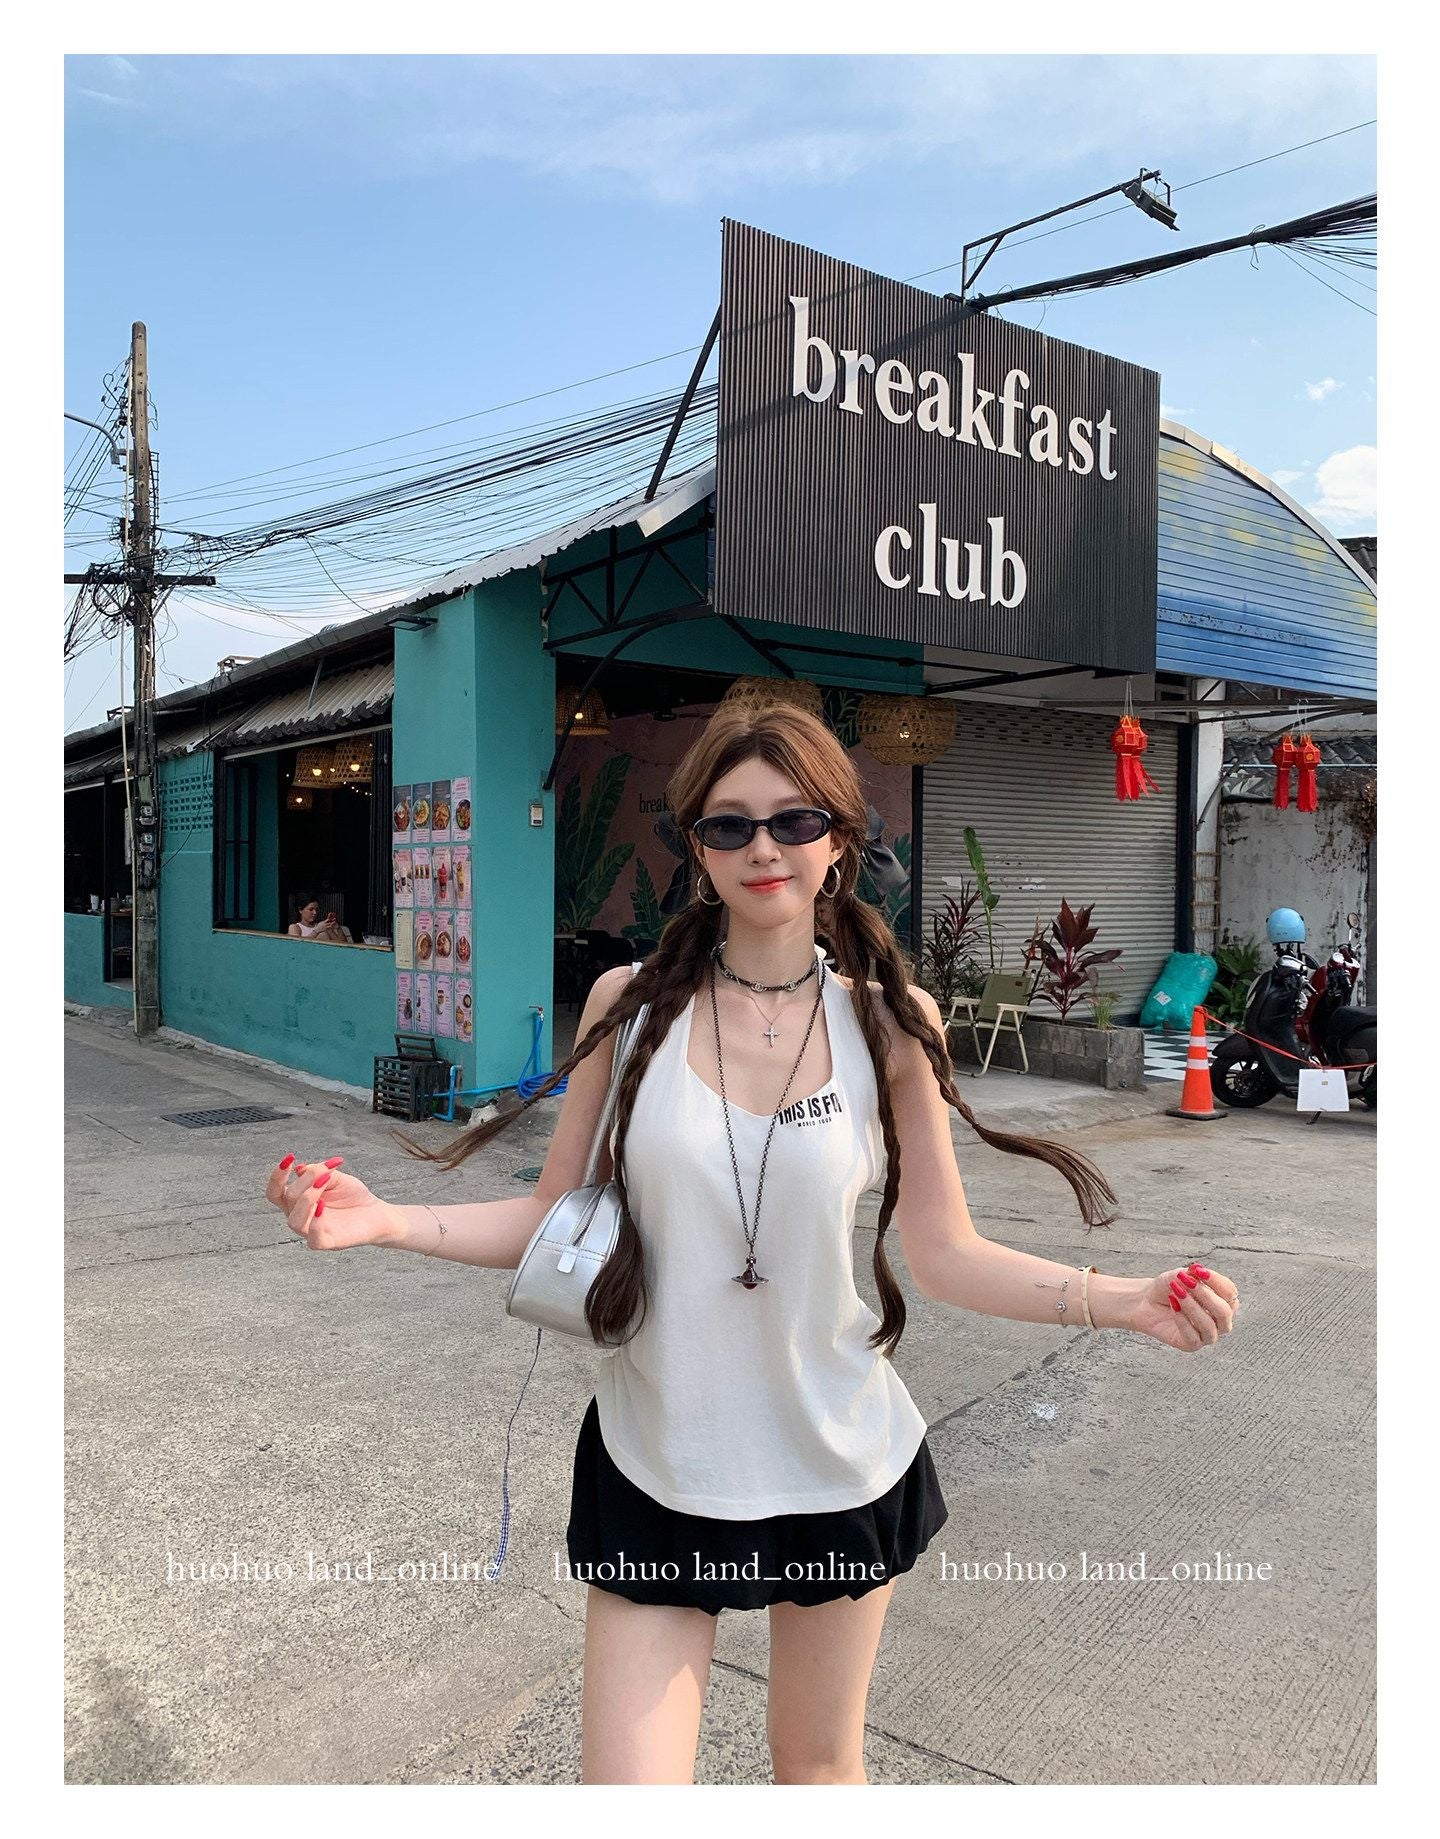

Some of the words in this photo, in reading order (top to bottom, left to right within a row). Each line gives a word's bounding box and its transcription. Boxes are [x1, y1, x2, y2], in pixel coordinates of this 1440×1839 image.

[789, 295, 1117, 481] breakfast
[874, 502, 1027, 609] club
[807, 1097, 821, 1117] IS
